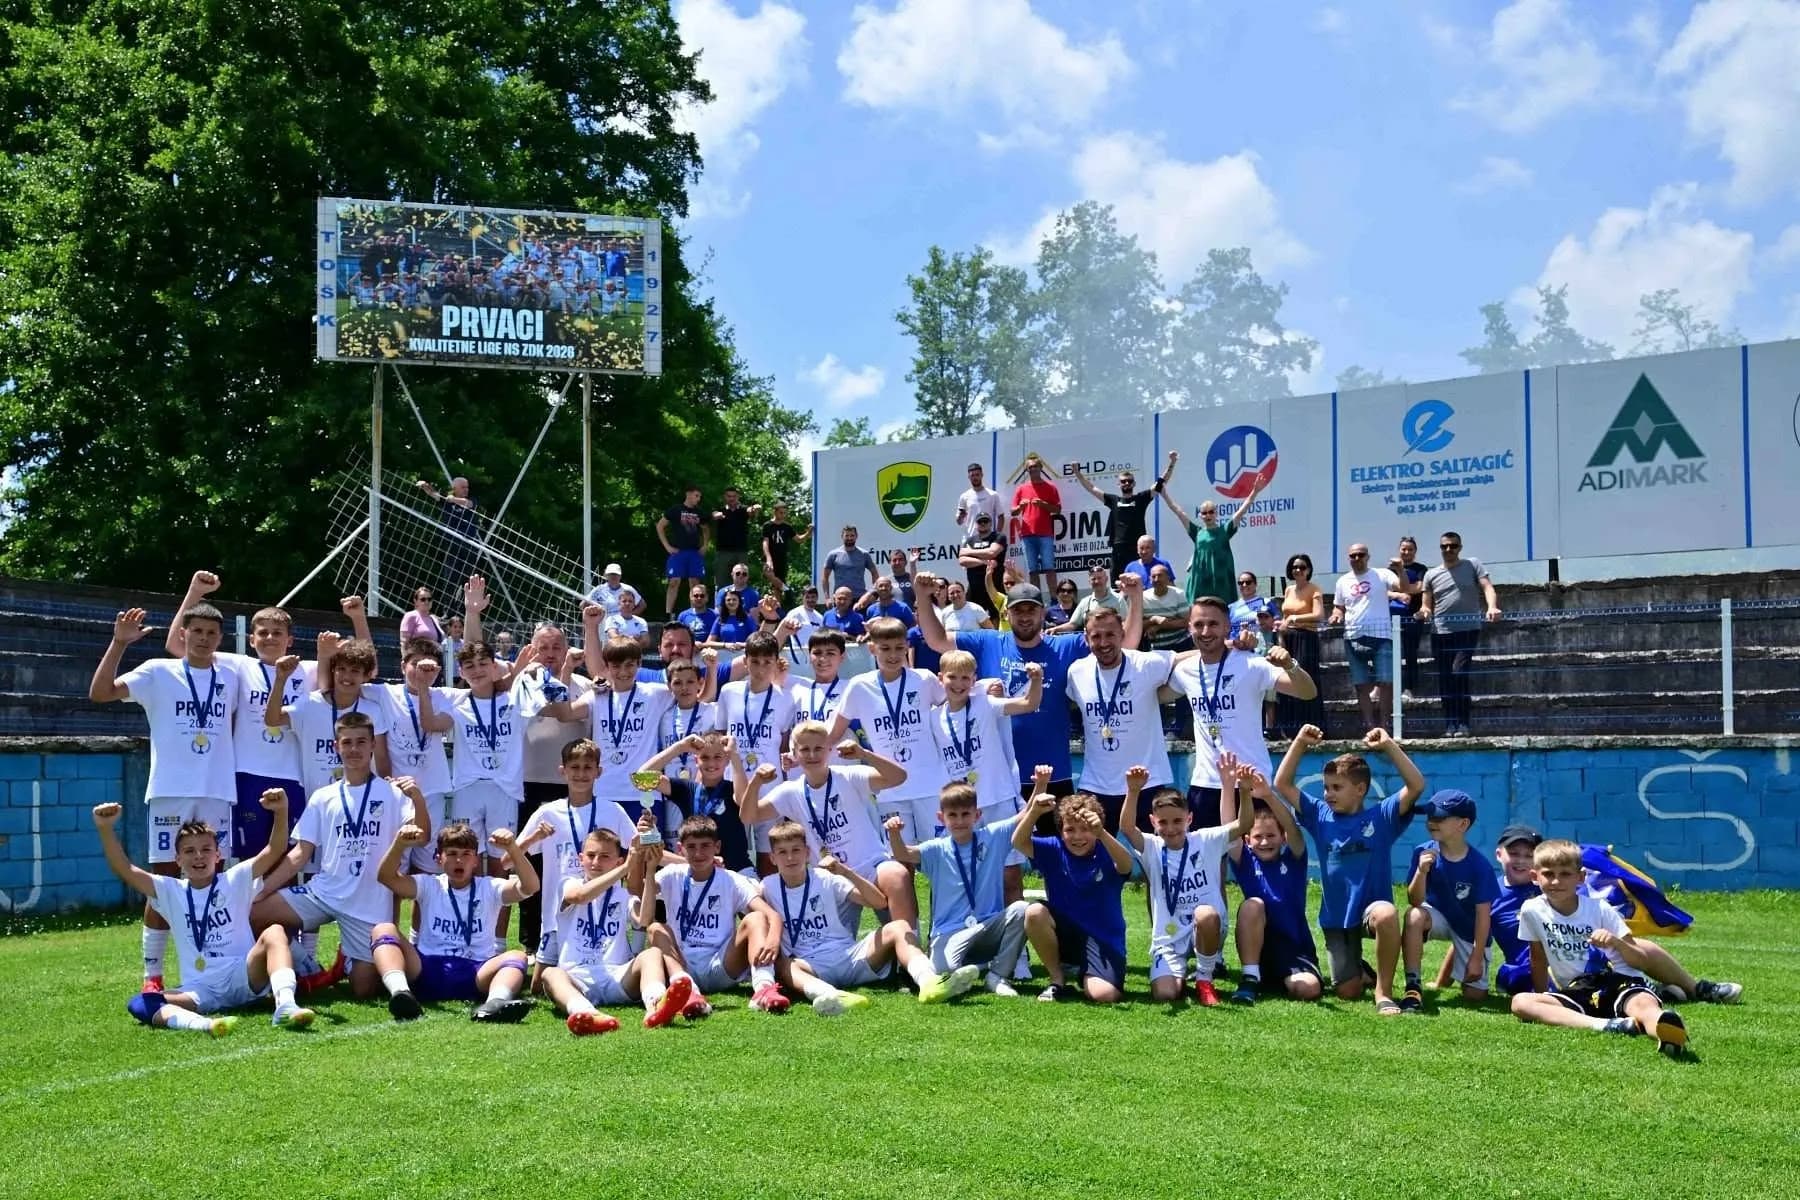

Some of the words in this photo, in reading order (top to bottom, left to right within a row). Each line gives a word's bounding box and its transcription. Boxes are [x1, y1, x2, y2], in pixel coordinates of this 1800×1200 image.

[442, 305, 544, 341] PRVACI
[409, 338, 476, 354] KVALITETNE
[477, 341, 502, 355] LIGE
[522, 344, 544, 358] ZDK
[1351, 462, 1425, 483] ELEKTRO
[1430, 449, 1514, 475] SALTAGIĆ
[1577, 461, 1709, 492] ADIMARK
[1250, 515, 1276, 527] BRKA
[1072, 541, 1088, 553] WEB
[158, 832, 170, 850] 8
